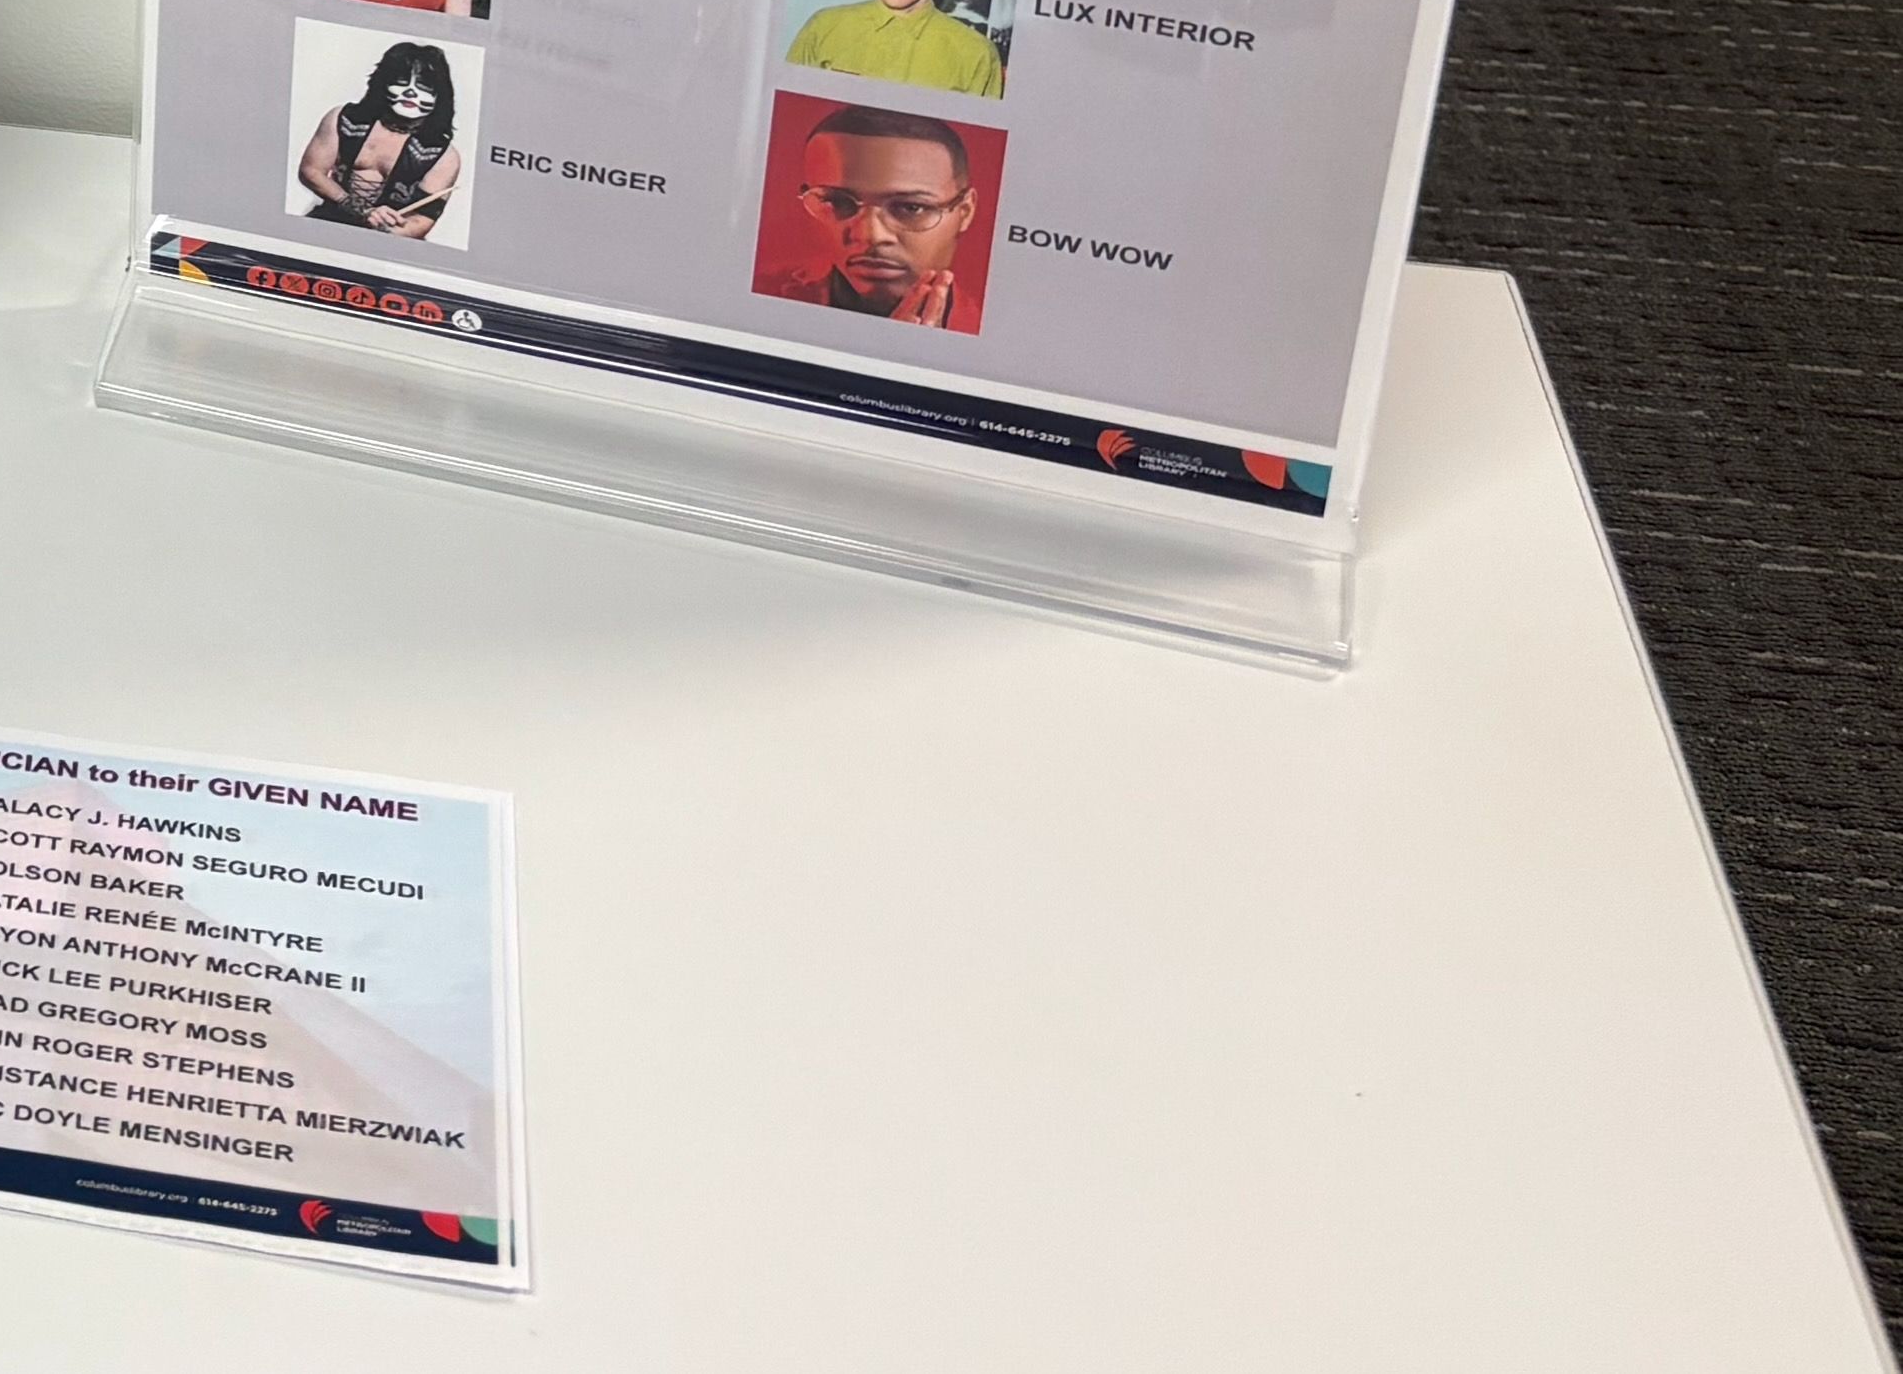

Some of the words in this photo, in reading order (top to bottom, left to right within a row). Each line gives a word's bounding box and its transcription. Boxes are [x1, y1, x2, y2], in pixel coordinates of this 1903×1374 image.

[1105, 8, 1255, 51] INTERIOR
[490, 145, 552, 173] ERIC
[562, 161, 666, 194] SINGER
[1008, 225, 1082, 253] BOW
[1091, 240, 1173, 270] WOW
[839, 392, 967, 426] columbuslibrary.org
[979, 420, 1072, 447] 614-645-2275
[88, 765, 119, 783] to
[128, 769, 200, 792] their
[208, 778, 309, 807] GIVEN
[320, 792, 418, 821] NAME
[87, 811, 108, 826] J.
[118, 814, 241, 842] HAWKINS
[70, 839, 183, 867] RAYMON
[192, 855, 308, 883] SEGURO
[317, 872, 423, 900] MECUDI
[90, 874, 184, 900] BAKER
[85, 906, 177, 932] RENÉE
[185, 920, 323, 953] McINTYRE
[14, 1104, 111, 1134] DOYLE
[119, 1121, 293, 1162] MENSINGER
[127, 1085, 287, 1124] HENRIETTA
[296, 1110, 464, 1149] MIERZWIAK
